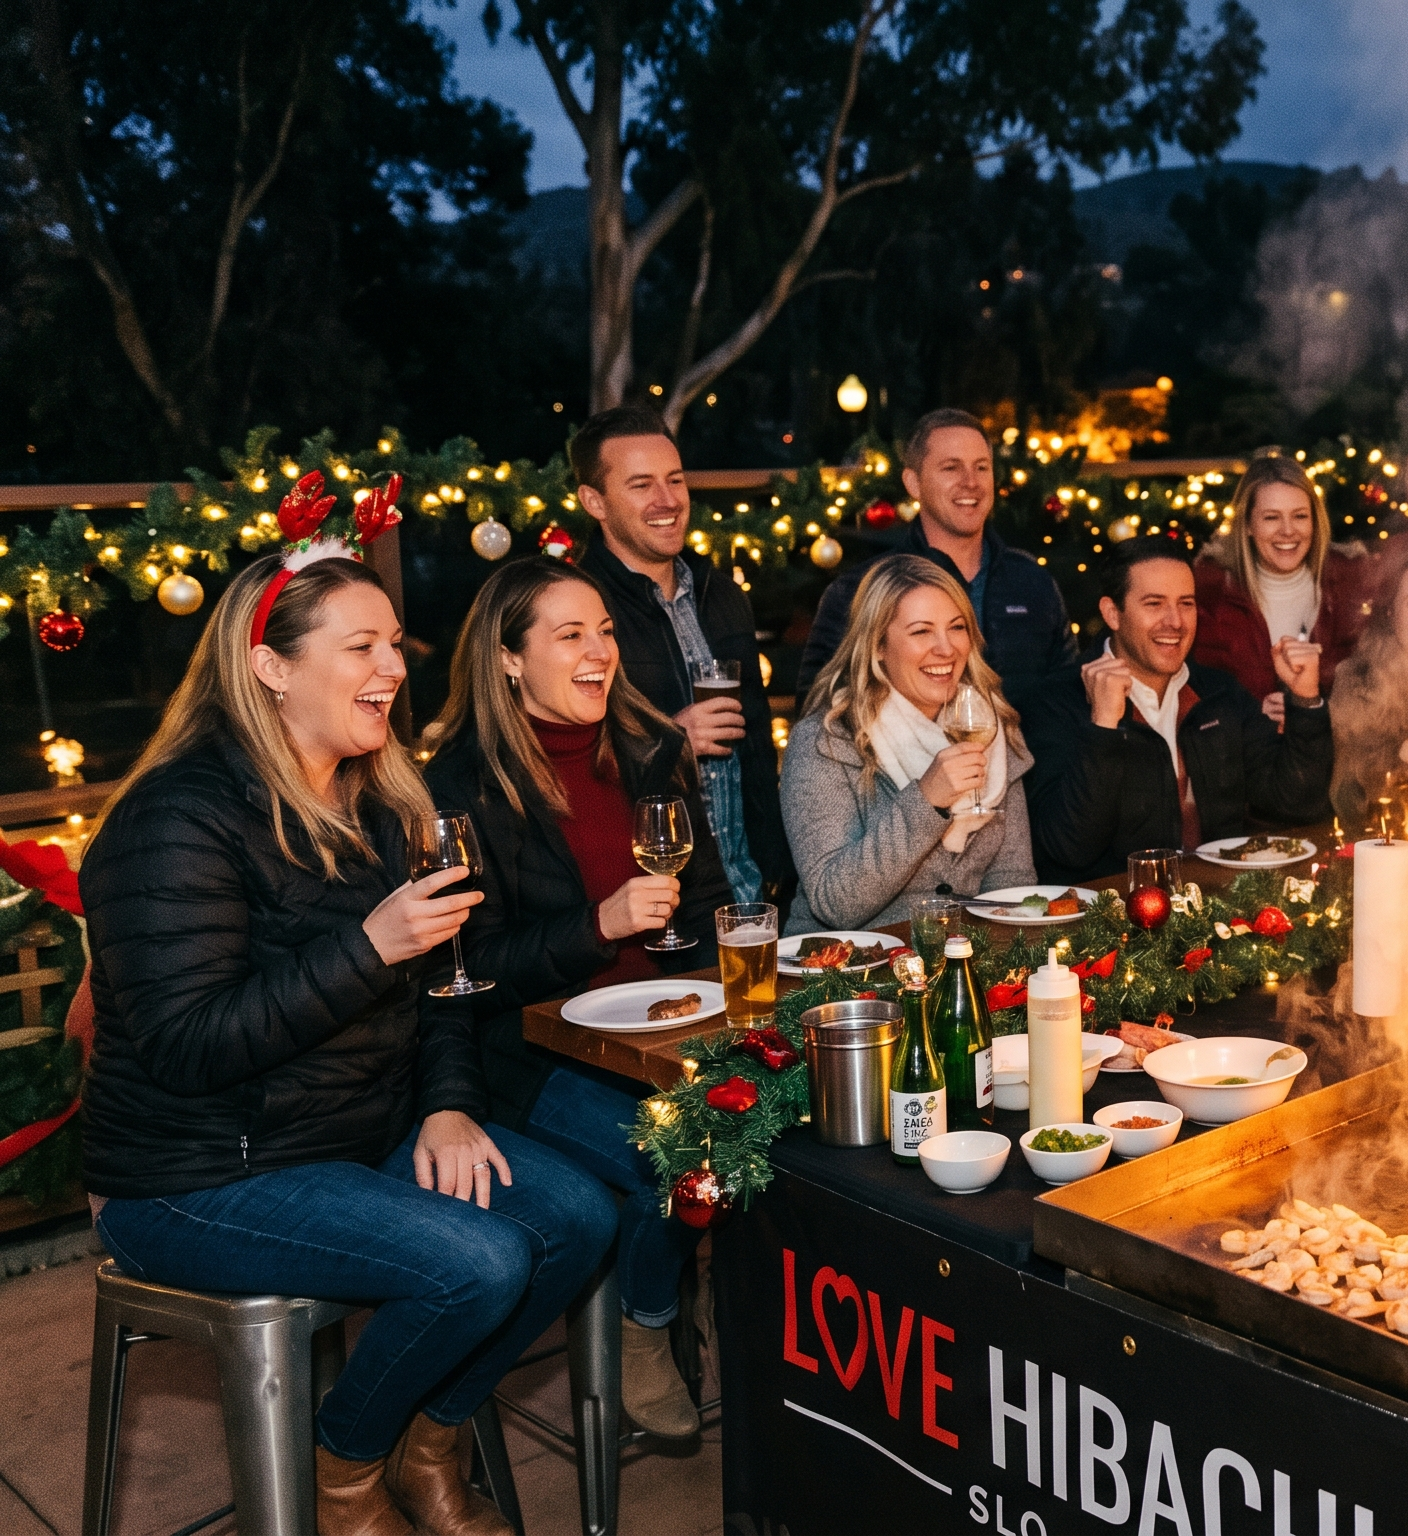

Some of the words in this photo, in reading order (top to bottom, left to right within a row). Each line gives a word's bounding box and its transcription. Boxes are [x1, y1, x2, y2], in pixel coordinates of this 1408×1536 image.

[784, 1248, 959, 1450] LOVE
[988, 1345, 1374, 1536] HIBAC
[969, 1485, 1047, 1536] SLO
